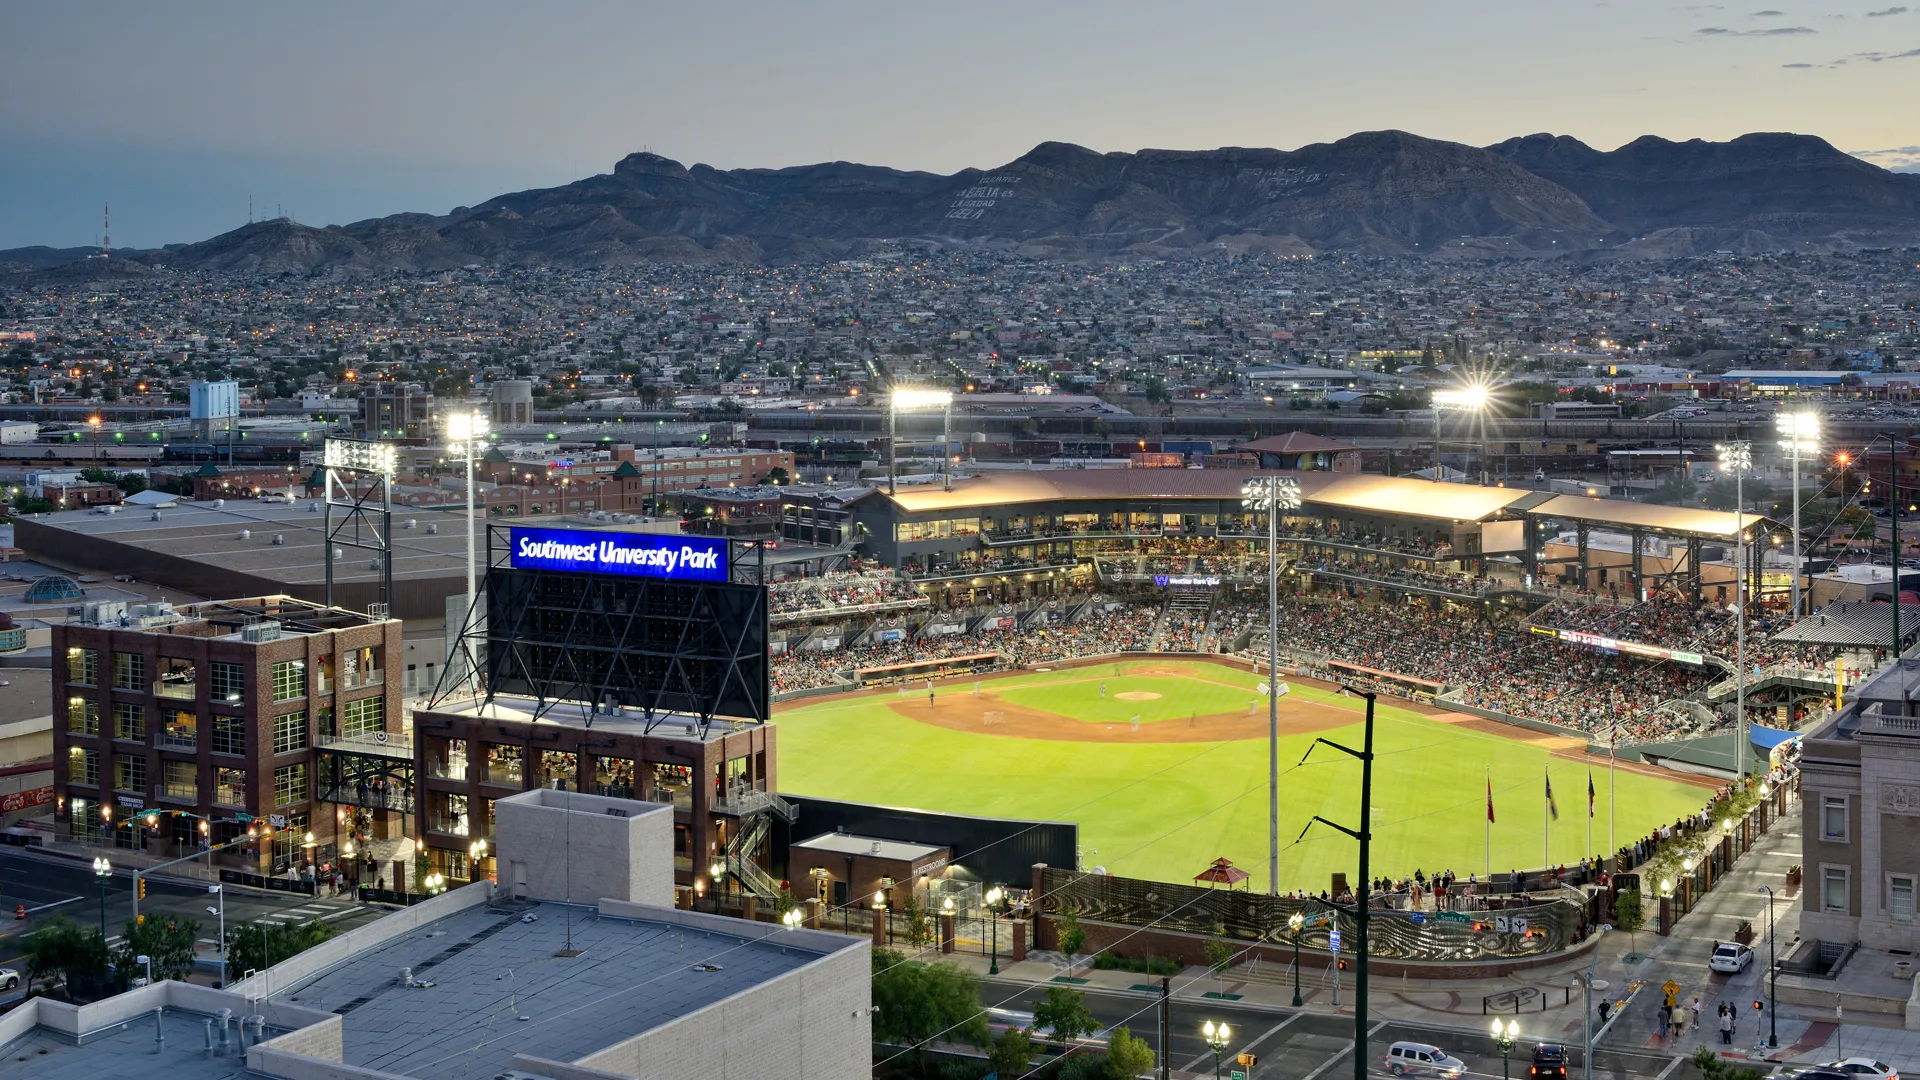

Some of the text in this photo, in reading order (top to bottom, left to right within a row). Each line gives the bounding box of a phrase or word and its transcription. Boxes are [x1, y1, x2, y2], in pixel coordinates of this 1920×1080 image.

[518, 537, 718, 572] Southwest University Park
[917, 858, 946, 875] RESTROOMS
[1440, 914, 1457, 922] Santa
